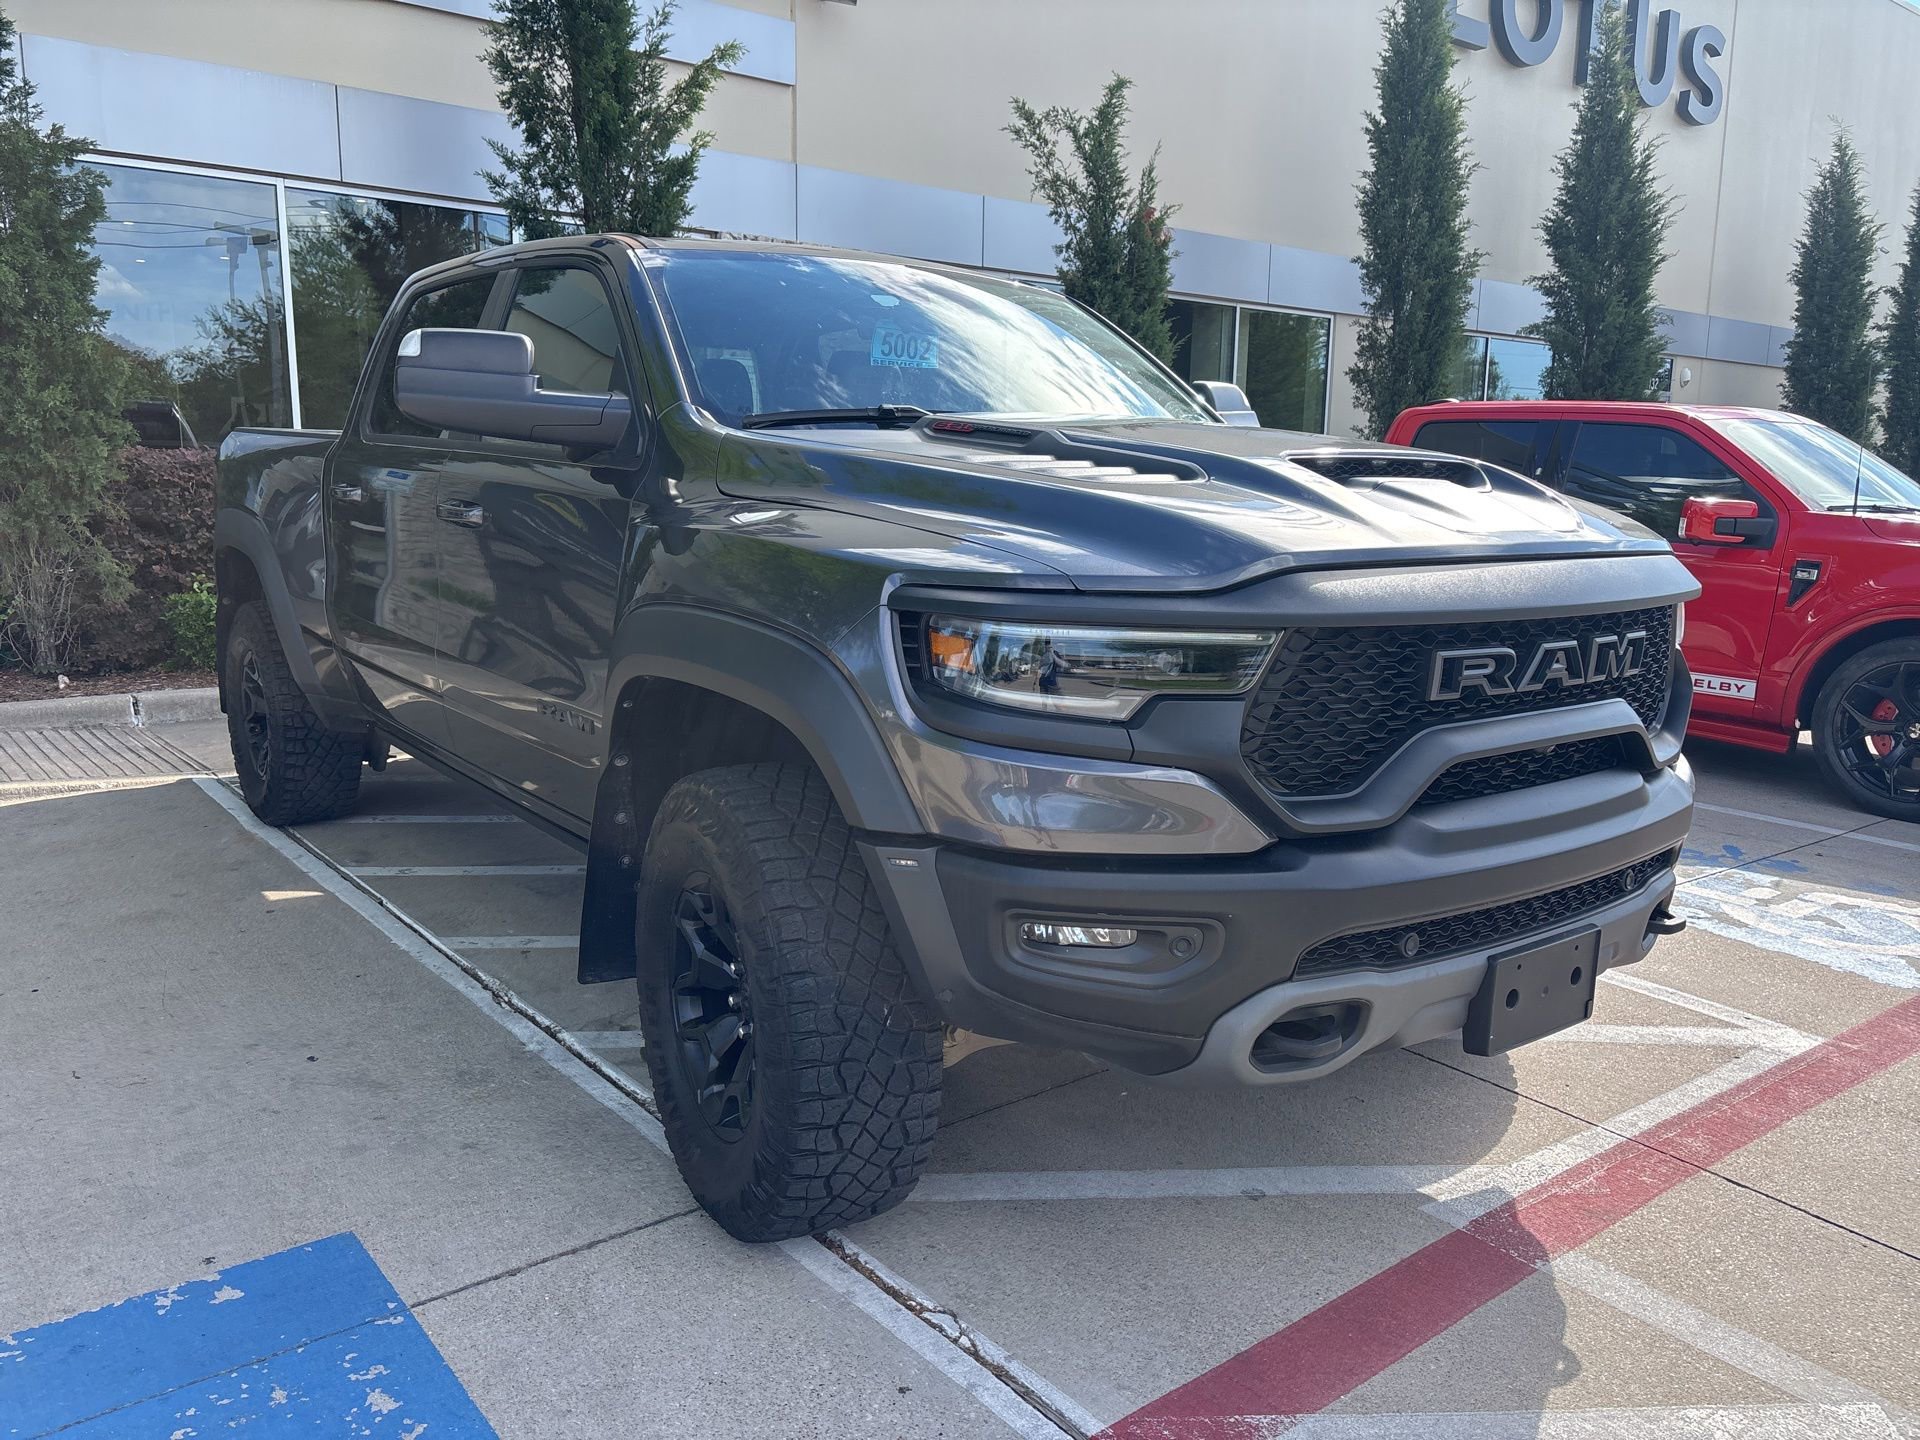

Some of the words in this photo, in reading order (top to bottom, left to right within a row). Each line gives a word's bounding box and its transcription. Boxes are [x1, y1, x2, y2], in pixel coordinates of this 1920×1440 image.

[1451, 0, 1726, 125] OUS
[880, 330, 932, 360] 5002
[1430, 630, 1646, 701] RAM
